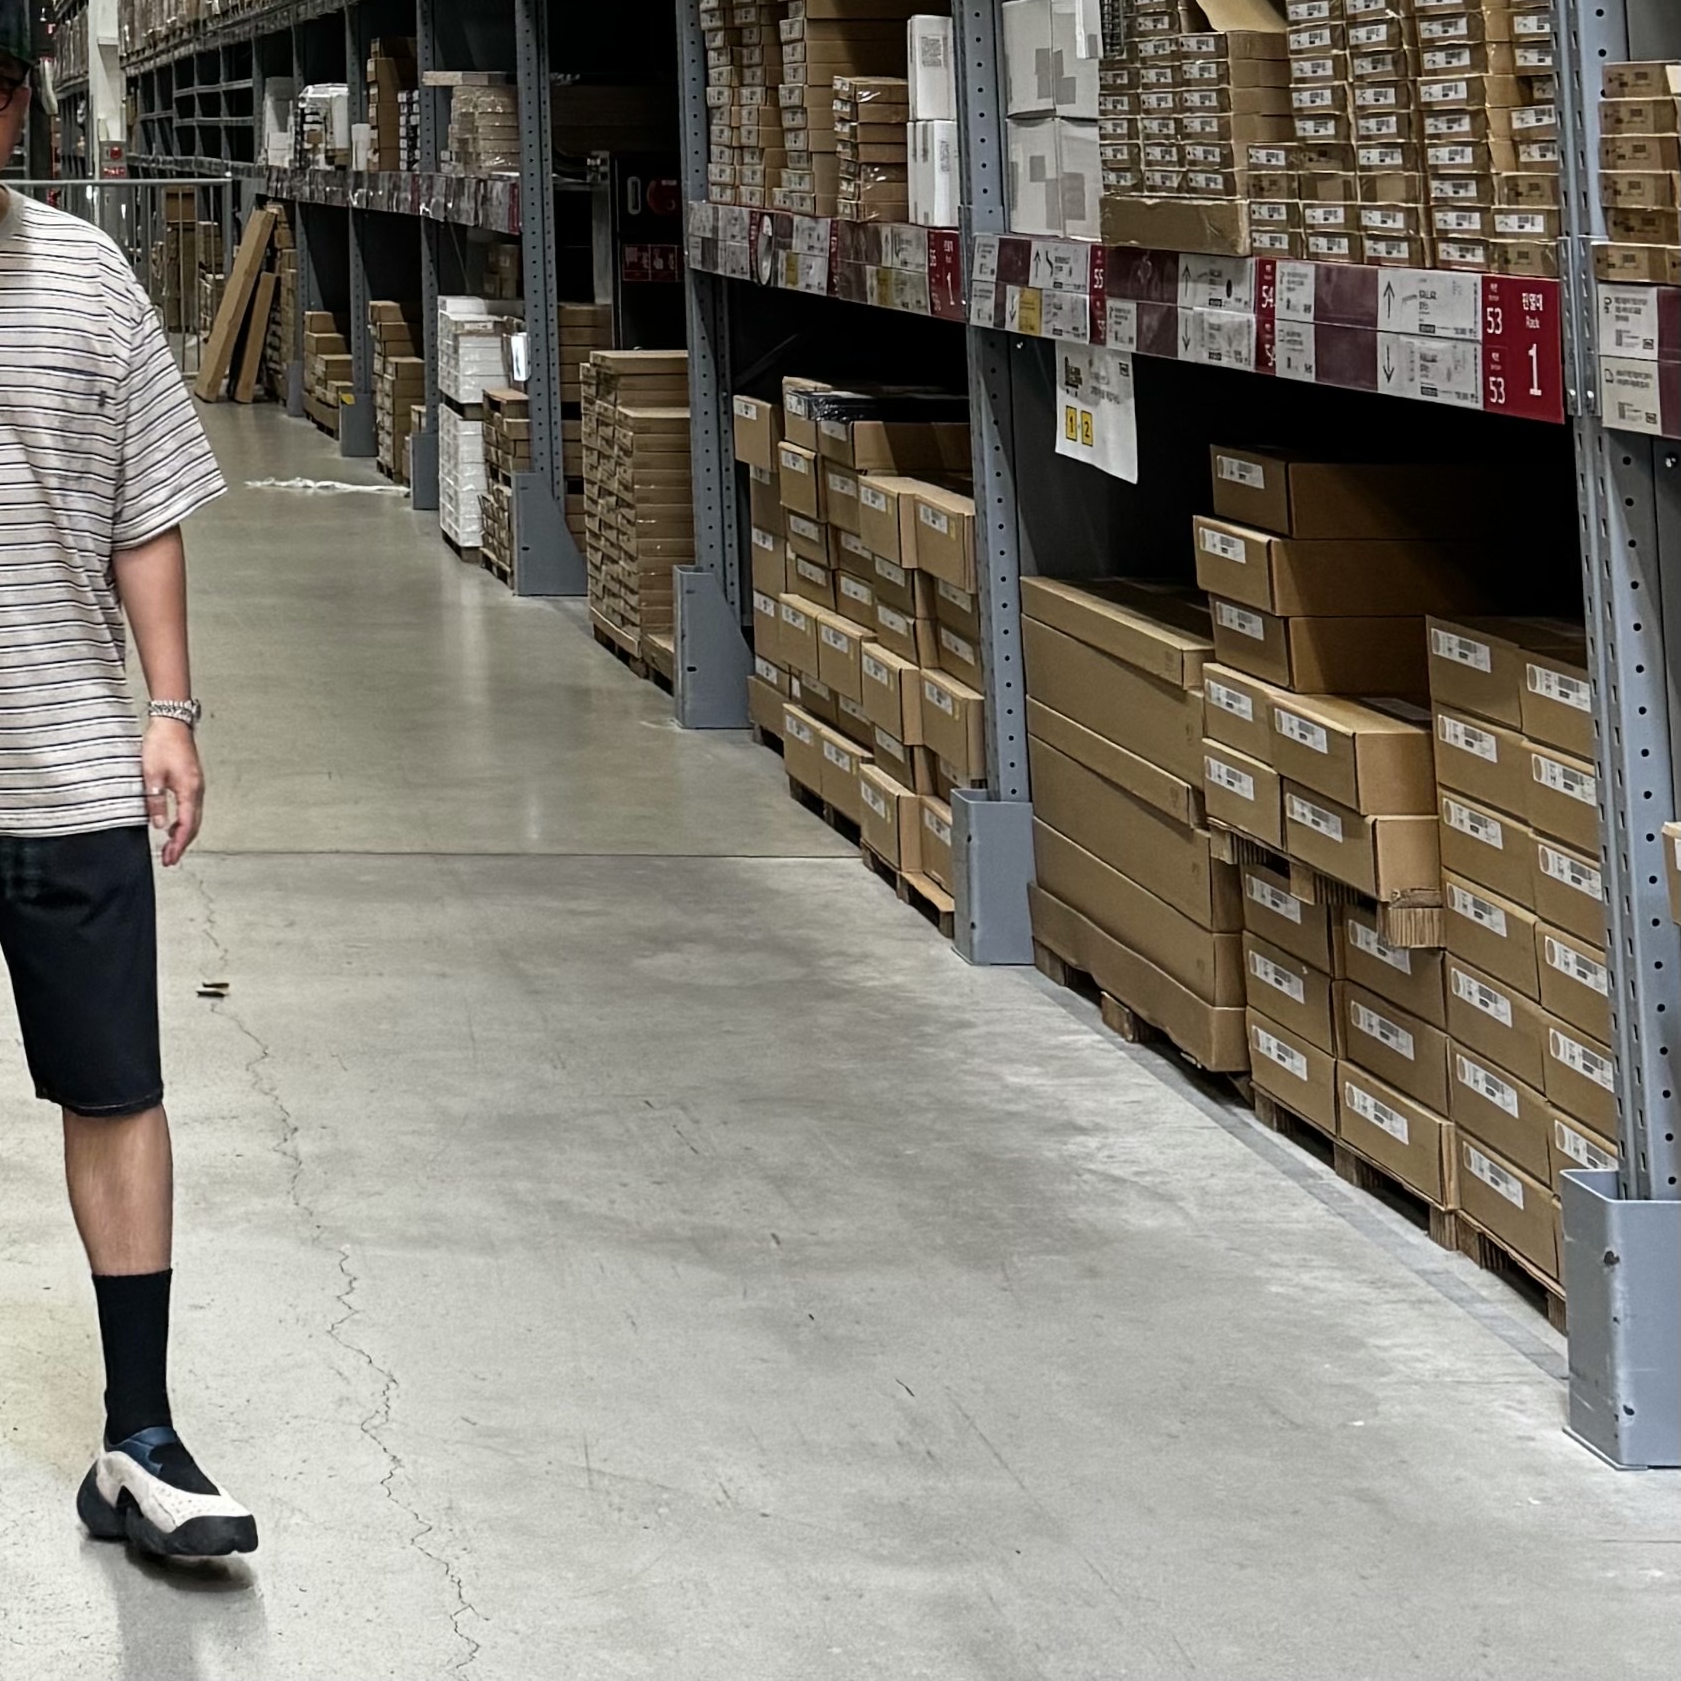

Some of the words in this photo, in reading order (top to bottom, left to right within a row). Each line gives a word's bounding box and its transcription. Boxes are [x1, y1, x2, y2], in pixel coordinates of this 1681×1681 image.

[946, 271, 955, 306] 1
[1261, 285, 1275, 308] 54
[1486, 307, 1503, 335] 53
[1528, 343, 1542, 396] 1
[1489, 376, 1506, 404] 53
[1084, 421, 1090, 438] 2
